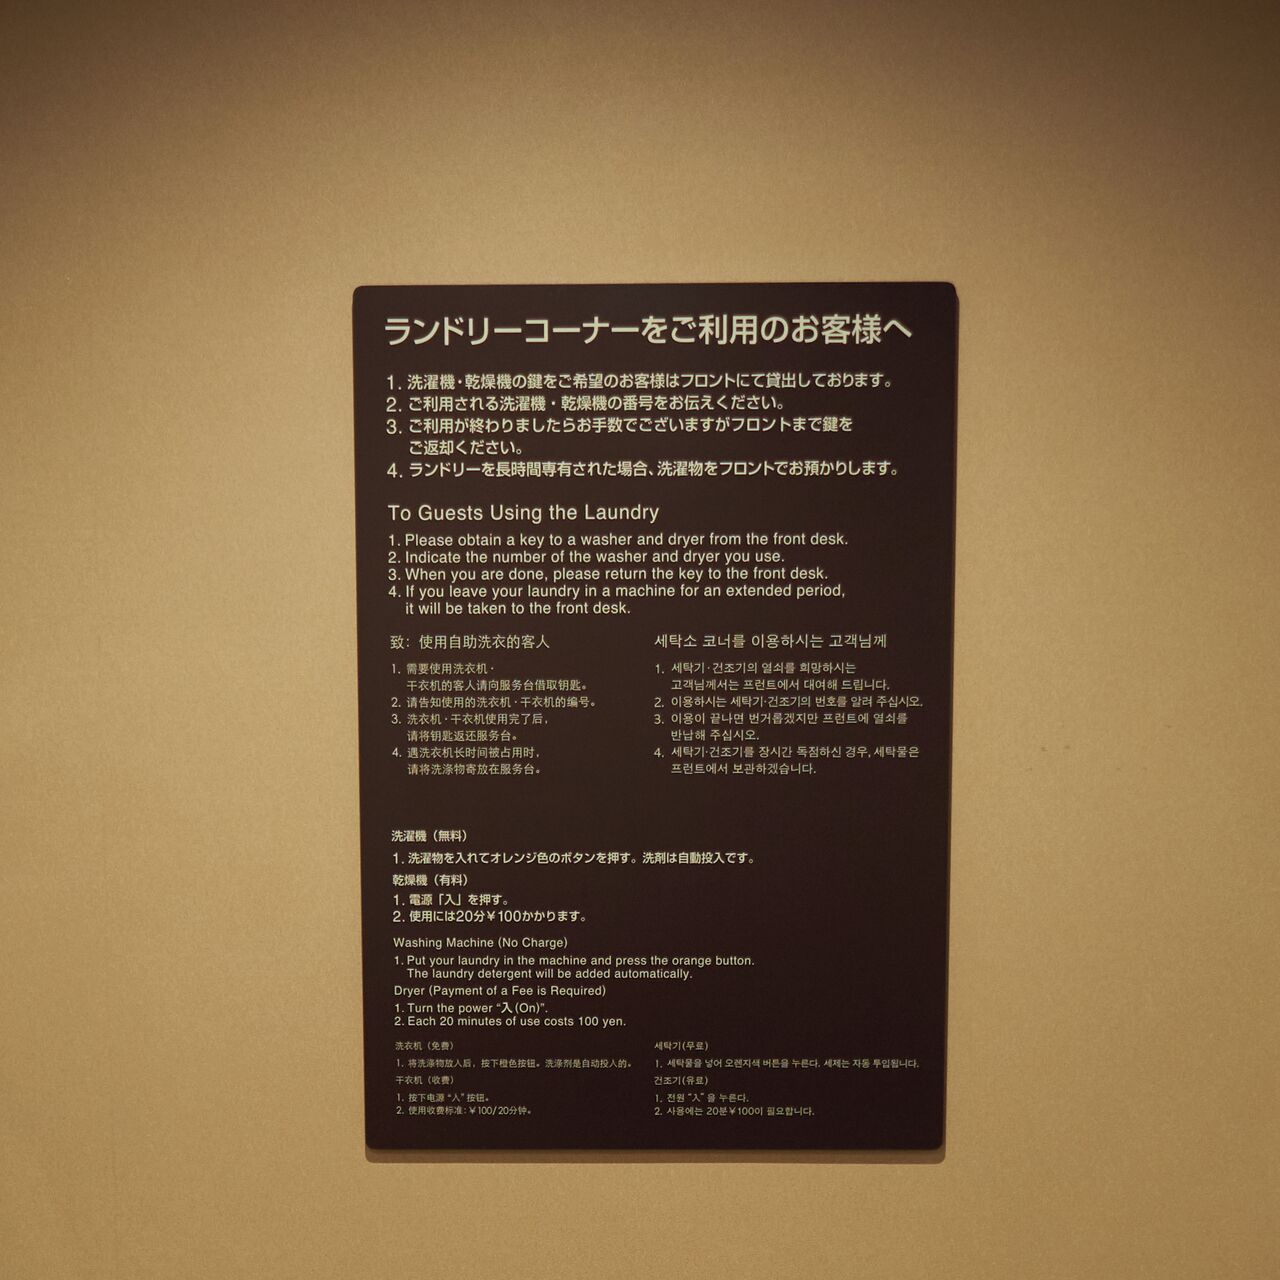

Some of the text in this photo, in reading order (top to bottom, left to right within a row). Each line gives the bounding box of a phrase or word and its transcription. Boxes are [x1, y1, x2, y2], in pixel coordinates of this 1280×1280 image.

[385, 314, 912, 346] ランドリーコーナーをご利用のお客様へ
[408, 372, 890, 390] 洗濯機・乾燥機の鍵をご希望のお客様はフロントにて貸出しております。
[409, 395, 783, 412] ご利用される洗濯機・乾燥機の番号をお伝えください。
[410, 416, 852, 434] ご利用が終わりましたらお手数でございますがフロントまで鍵を
[410, 440, 522, 456] ご返却ください。
[410, 460, 897, 477] ランドリーを長時間専有された場合、洗濯物をフロントでお預かりします。
[388, 504, 659, 524] To Guests Using the Laundry
[389, 532, 848, 549] 1. Please obtain a key to a washer and dryer from the front desk.
[388, 550, 784, 566] 2. Indicate the number of the washer and dryer you use.
[388, 567, 828, 584] 3. When you are done, please return the key to the front desk.
[388, 584, 845, 601] 4. If you leave your laundry in a machine for an extended period,
[406, 602, 630, 615] it will be taken to the front desk.
[654, 634, 886, 649] 세탁소 코너를 이용하시는 고객님께
[409, 894, 507, 906] 電源「入」を押す。
[410, 910, 585, 922] 使用には20分¥100かかります。
[393, 937, 568, 950] Washing Machine (No Charge)
[395, 955, 754, 968] 1. Put your laundry in the machine and press the orange button.
[407, 968, 692, 981] The laundry detergent will be added automatically.
[394, 986, 425, 998] Dryer
[429, 985, 483, 998] (Payment
[486, 986, 497, 996] of
[512, 986, 533, 996] Fee
[538, 986, 547, 996] is
[551, 985, 606, 998] Required)
[395, 1004, 404, 1013] 1.
[408, 1003, 433, 1013] Turn
[437, 1003, 454, 1013] the
[459, 1005, 493, 1015] power
[394, 1016, 626, 1029] 2. Each 20 minutes of use costs 100 yen.
